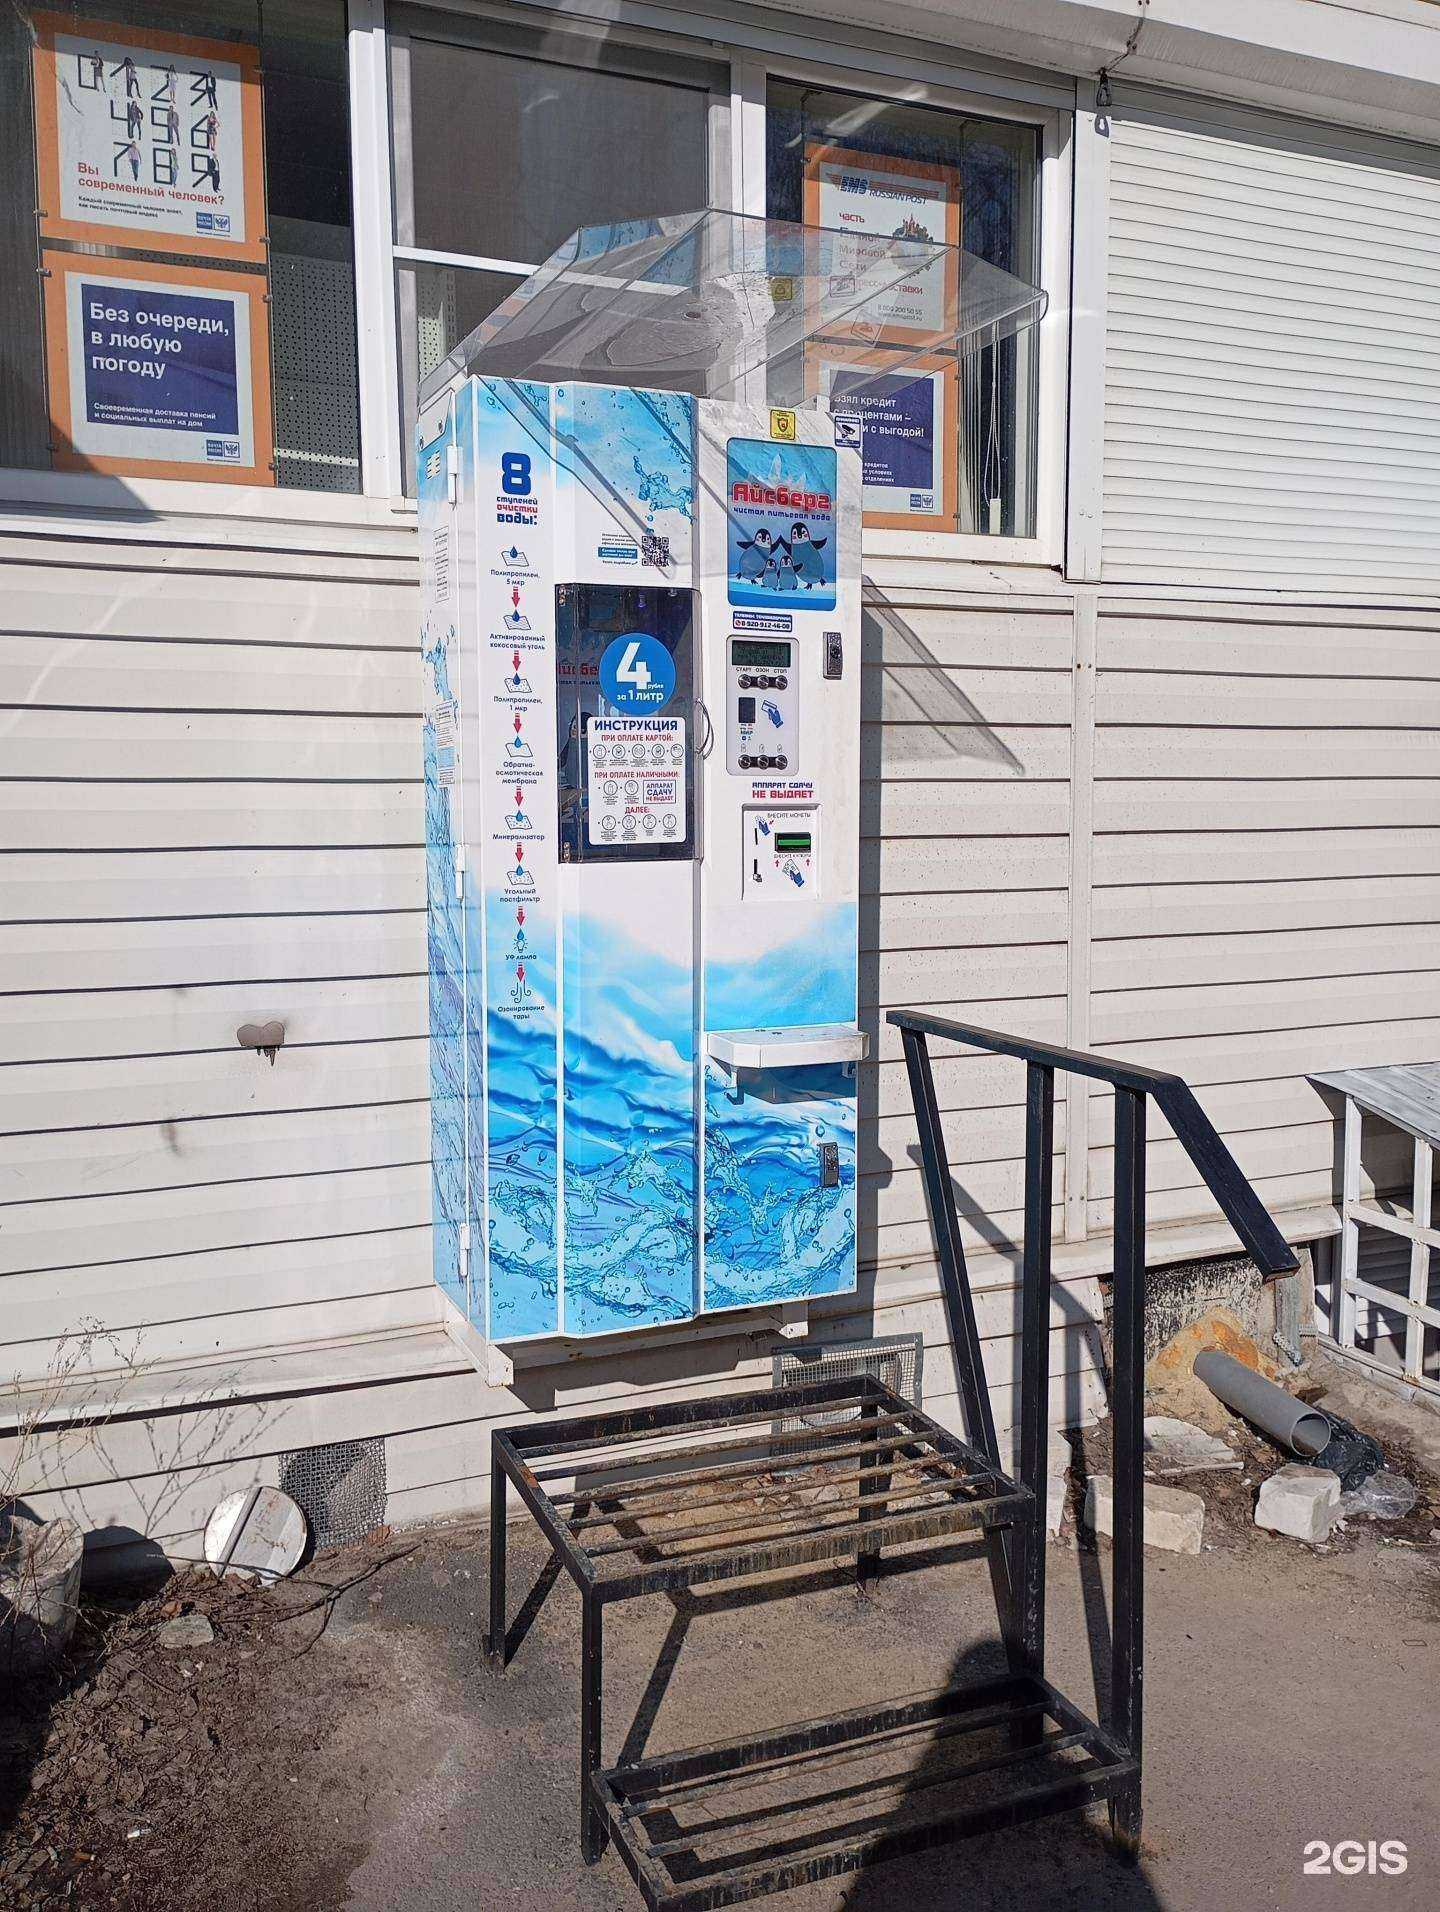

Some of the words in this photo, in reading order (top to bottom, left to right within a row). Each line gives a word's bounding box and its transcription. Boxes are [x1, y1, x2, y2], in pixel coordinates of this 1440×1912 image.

[78, 162, 99, 176] Вы
[78, 177, 165, 197] современный
[169, 191, 225, 205] человек?
[870, 189, 905, 201] RUSSIAN
[906, 192, 928, 205] POST
[839, 212, 865, 223] часть
[90, 302, 130, 323] Без
[136, 310, 229, 337] очереди,
[91, 331, 102, 344] в
[109, 333, 182, 354] любую
[92, 355, 165, 380] погоду
[860, 398, 896, 408] кредит
[93, 402, 154, 415] Своевременная
[155, 409, 189, 418] доставка
[190, 411, 216, 420] пенсий
[101, 413, 148, 423] социальных
[149, 417, 176, 425] выплат
[188, 420, 203, 428] дом
[880, 426, 924, 438] выгодой!
[502, 452, 531, 495] 8
[497, 496, 538, 505] ступеней
[733, 482, 831, 511] Айсберг
[497, 504, 538, 513] очистки
[733, 507, 765, 516] чистая
[767, 510, 809, 520] питьевая
[497, 513, 538, 525] воды:
[490, 569, 540, 579] Полипропилен,
[489, 633, 546, 642] Активированный
[490, 642, 527, 650] кокосовый
[616, 642, 651, 690] 4
[494, 696, 543, 705] Полипропилен,
[629, 690, 634, 701] 1
[636, 692, 664, 703] литр
[595, 720, 678, 732] ИНСТРУКЦИЯ
[601, 734, 616, 742] ПРИ
[618, 734, 644, 742] ОПЛАТЕ
[645, 733, 674, 742] КАРТОЙ:
[503, 761, 535, 769] Обратно-
[496, 769, 544, 777] осмотическая
[594, 771, 608, 779] ПРИ
[609, 771, 634, 779] ОПЛАТЕ
[752, 790, 766, 799] НЕ
[770, 790, 814, 799] ВЫДАЕТ
[624, 806, 650, 814] ДАЛЕЕ:
[493, 833, 545, 841] Минерализатор
[500, 895, 540, 903] постфильтр
[497, 1005, 545, 1013] Озонирование
